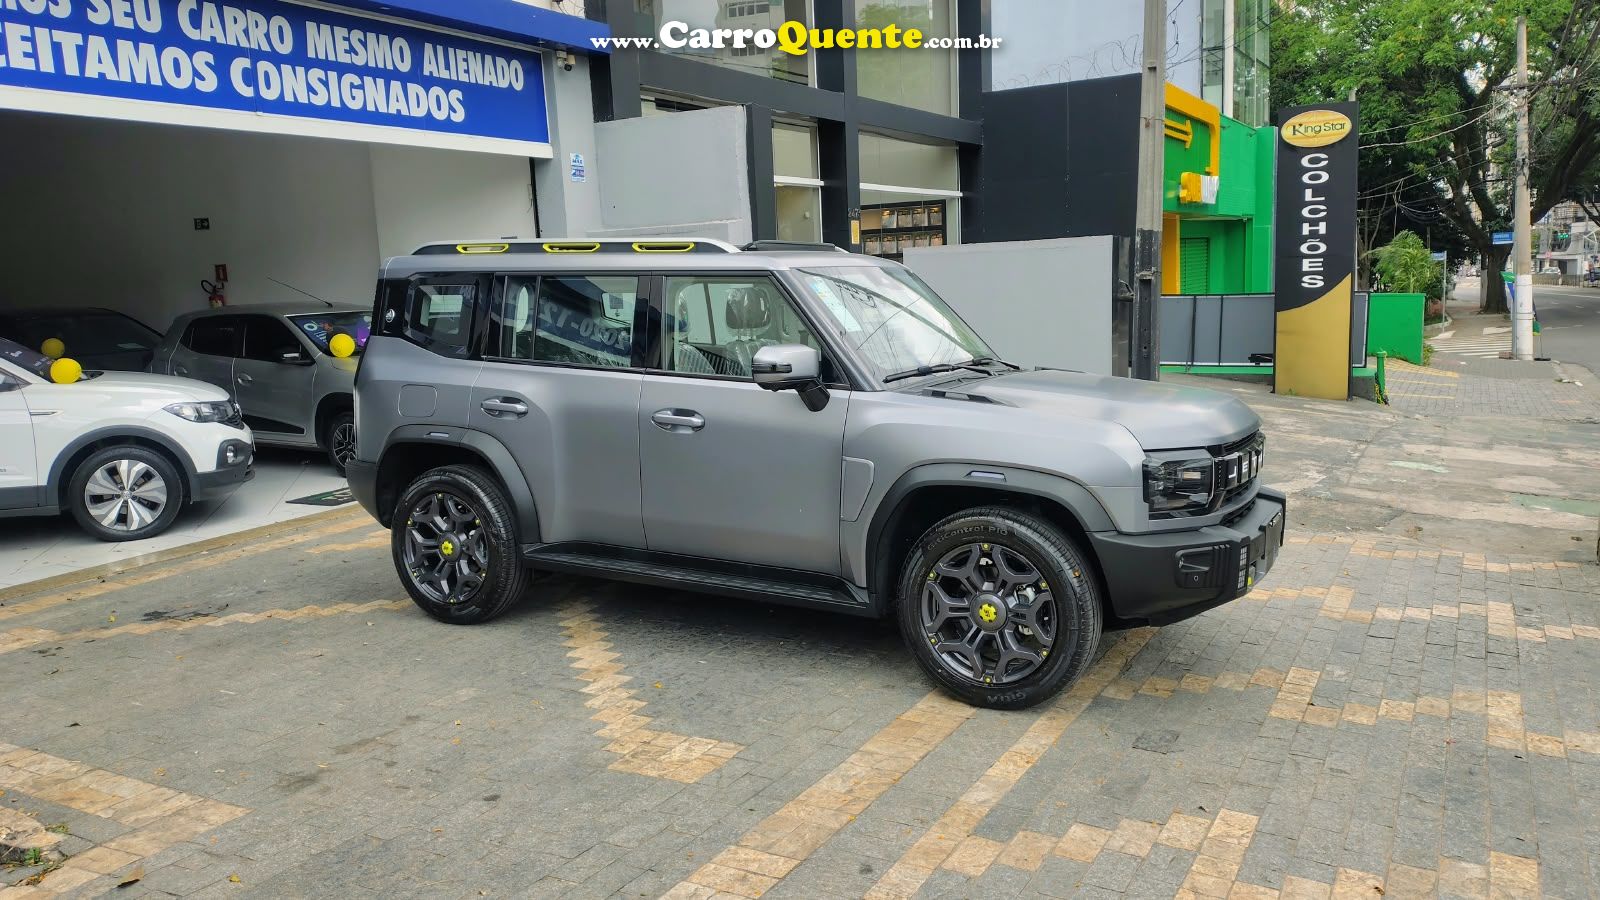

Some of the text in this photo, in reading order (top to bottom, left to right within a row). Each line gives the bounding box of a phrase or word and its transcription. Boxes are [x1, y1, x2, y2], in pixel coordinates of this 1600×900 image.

[0, 21, 466, 123] EITAMOS CONSIGNADOS
[86, 0, 525, 92] SEU CARRO MESMO ALIENADO
[1292, 121, 1346, 138] King Star
[1300, 153, 1330, 289] COLCHÕES
